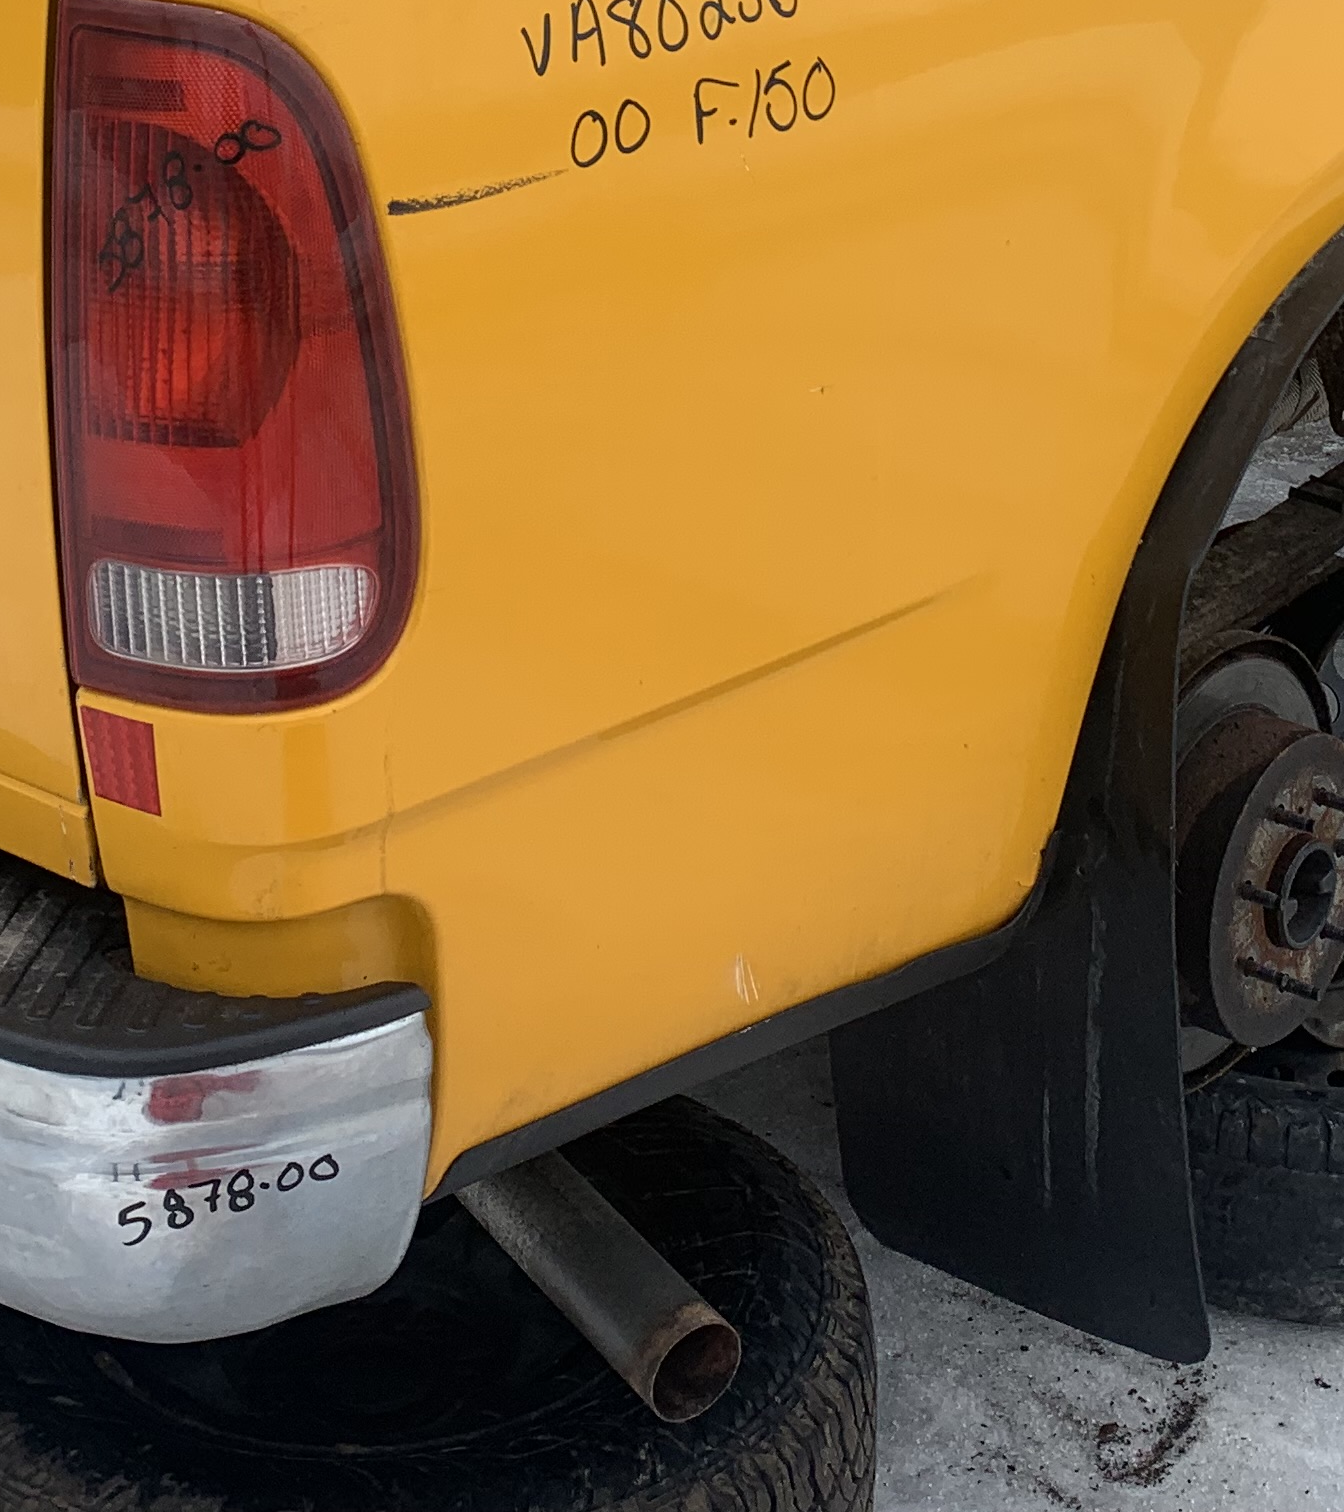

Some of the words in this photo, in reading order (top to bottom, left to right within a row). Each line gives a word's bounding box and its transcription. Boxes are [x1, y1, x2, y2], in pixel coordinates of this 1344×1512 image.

[571, 98, 651, 168] 00
[98, 119, 282, 294] 5878.00
[117, 1153, 340, 1247] 5878.00
